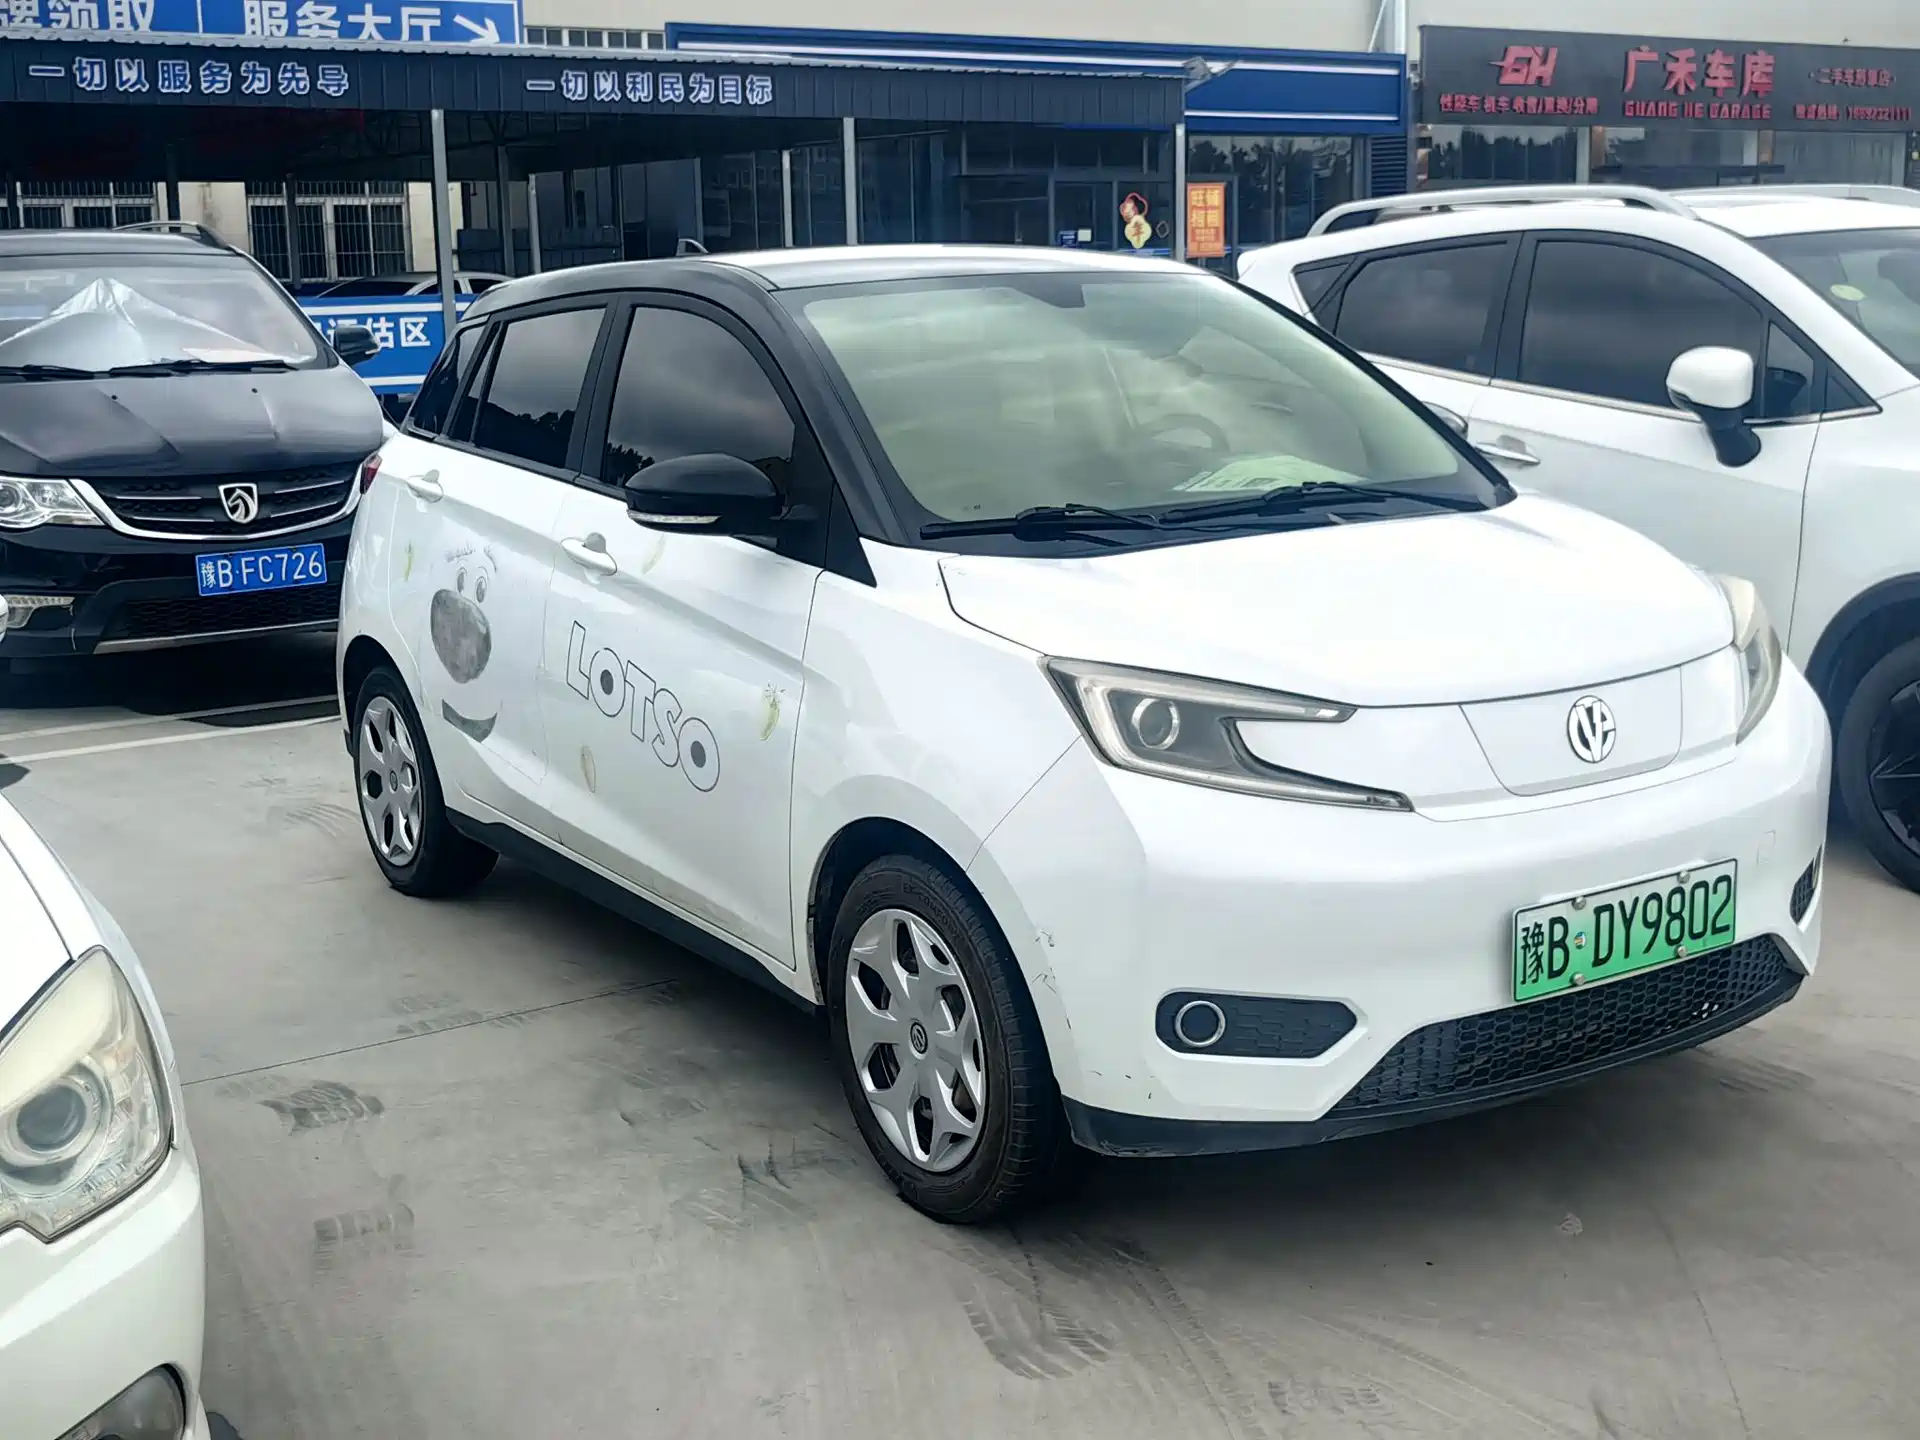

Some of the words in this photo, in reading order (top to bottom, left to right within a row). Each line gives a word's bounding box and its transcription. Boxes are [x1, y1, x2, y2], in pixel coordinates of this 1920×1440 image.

[244, 0, 441, 42] 服务大厅
[29, 56, 350, 96] 一切以服务为先导
[526, 69, 773, 104] 一切以利民为目标
[1623, 44, 1776, 98] 广禾车库
[1624, 100, 1678, 118] GUANG
[1709, 101, 1773, 120] GARAGE
[566, 620, 720, 792] LOTSO
